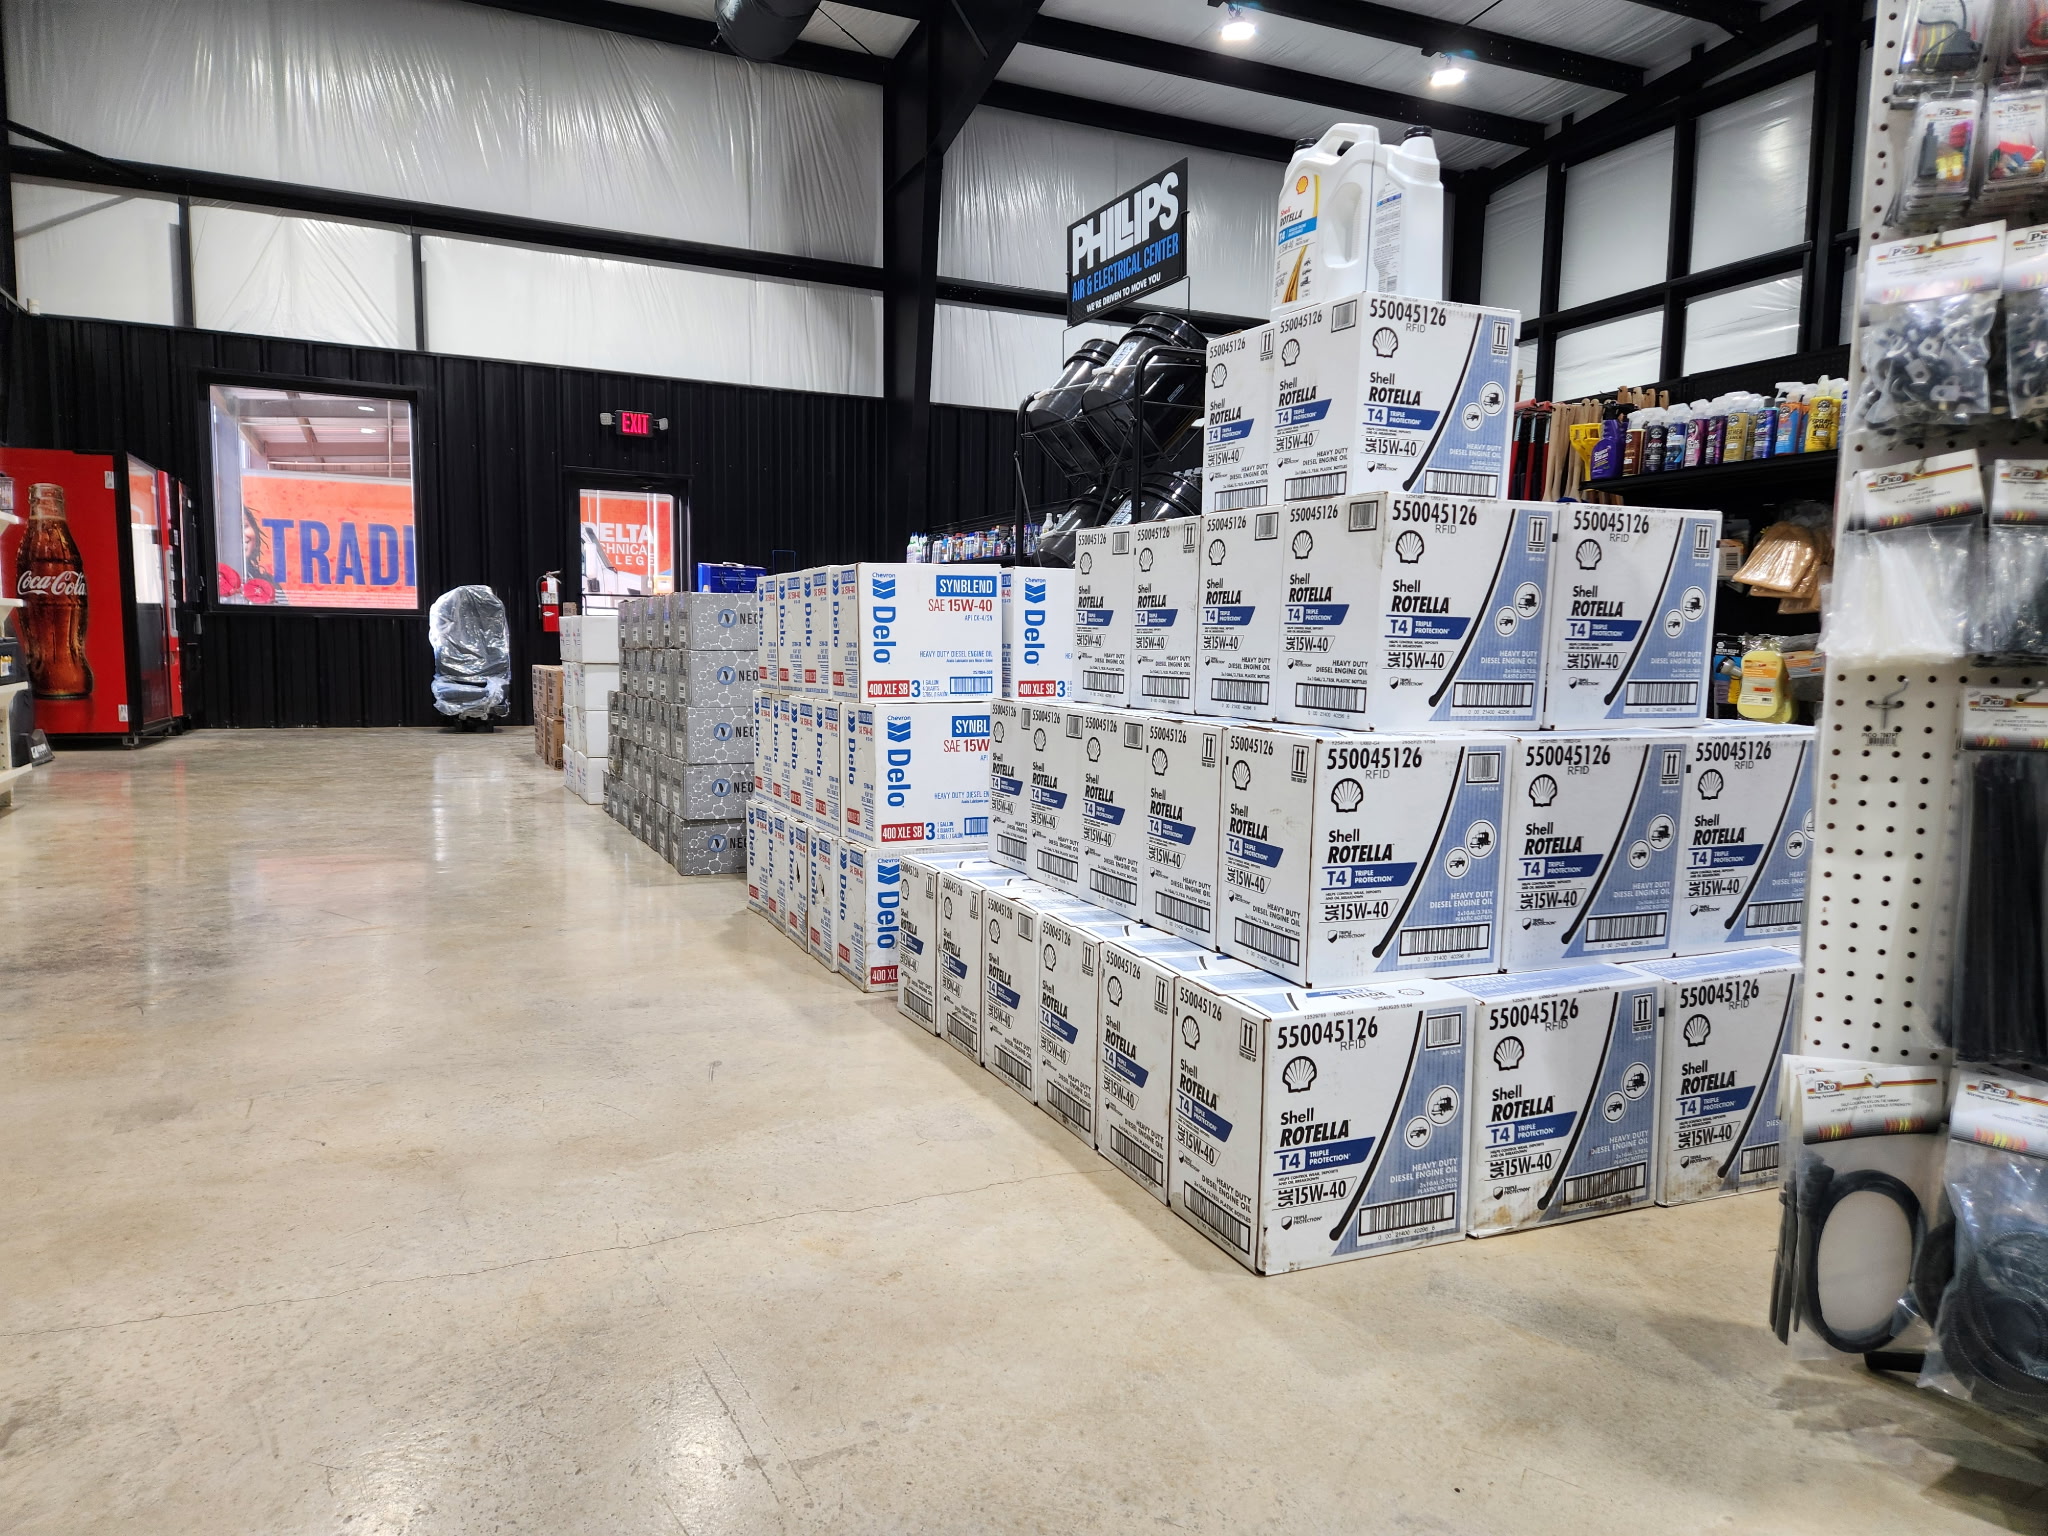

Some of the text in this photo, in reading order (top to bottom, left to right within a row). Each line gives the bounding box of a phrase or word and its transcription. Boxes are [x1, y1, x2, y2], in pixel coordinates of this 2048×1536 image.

[1072, 172, 1179, 277] PHILLIPS
[1072, 232, 1179, 302] AIR & ELECTRICAL CENTER
[1102, 290, 1122, 307] DRIVEN
[1122, 287, 1130, 298] TO
[1131, 279, 1147, 294] MOVE
[1148, 272, 1161, 286] YOU
[1370, 300, 1446, 326] 550045126
[1280, 312, 1322, 333] 550045126
[1406, 323, 1426, 333] RFID
[1210, 338, 1246, 359] 550045126
[1370, 372, 1395, 386] Shell
[1279, 386, 1317, 407] ROTELLA
[1369, 389, 1421, 406] ROTELLA
[622, 412, 649, 435] EXIT
[1368, 408, 1383, 422] T4
[1378, 438, 1416, 456] 15W-40
[1290, 505, 1338, 522] 550045126
[1392, 501, 1477, 525] 550045126
[1574, 511, 1649, 533] 550045126
[1207, 518, 1246, 532] 550045126
[1435, 524, 1456, 534] RFID
[616, 555, 654, 565] LEGE
[18, 570, 87, 596] Coca-Cola
[940, 579, 992, 593] SYNBLEND
[1207, 578, 1223, 588] Shell
[1393, 580, 1420, 592] Shell
[1573, 586, 1598, 598] Shell
[928, 599, 992, 611] SAE 15W-40
[1206, 590, 1241, 605] ROTELLA
[1391, 596, 1449, 614] ROTELLA
[1571, 601, 1623, 617] ROTELLA
[873, 606, 896, 664] Delo
[1391, 620, 1407, 634] T4
[1571, 623, 1585, 636] T4
[1025, 610, 1045, 664] Delo
[1388, 651, 1444, 668] SAE 15W-40
[1580, 653, 1618, 669] 15W-40
[739, 670, 758, 681] NEO
[869, 680, 921, 697] 400 XLE SB 3
[1019, 680, 1065, 697] 400 XLE SB 3
[956, 719, 989, 733] SYNBL
[1150, 727, 1186, 743] 550045126
[944, 739, 989, 752] SAE 15W
[1230, 735, 1273, 755] 550045126
[1696, 741, 1771, 762] 550045126
[848, 738, 856, 785] Delo
[1327, 747, 1422, 770] 550045126
[1526, 744, 1610, 767] 550045126
[887, 749, 911, 808] Delo
[1365, 770, 1390, 779] RFID
[1230, 804, 1248, 817] Shell
[1230, 817, 1268, 841] ROTELLA
[1526, 822, 1553, 835] Shell
[1694, 814, 1720, 826] Shell
[882, 822, 935, 840] 400 XLE SB 3
[1328, 829, 1360, 843] Shell
[1693, 827, 1745, 845] ROTELLA
[1328, 844, 1392, 863] ROTELLA
[1524, 836, 1582, 855] ROTELLA
[1692, 852, 1707, 865] T4
[1524, 862, 1540, 876] T4
[1327, 871, 1346, 886] T4
[1689, 878, 1739, 896] SAE 15W-40
[1520, 891, 1577, 909] SAE 15W-40
[877, 891, 899, 949] Delo
[1325, 901, 1388, 921] SAE 15W-40
[1043, 920, 1071, 946] 550045126
[1106, 949, 1141, 980] 550045126
[872, 968, 898, 981] 400 XL
[1680, 979, 1759, 1008] 550045126
[1180, 987, 1222, 1022] 550045126
[1729, 998, 1750, 1011] RFID
[1489, 998, 1579, 1030] 550045126
[1278, 1016, 1378, 1049] 550045126
[1545, 1019, 1568, 1032] RFID
[1340, 1038, 1366, 1051] RFID
[1181, 1059, 1198, 1079] Shell
[1682, 1060, 1708, 1076] Shell
[1180, 1073, 1218, 1111] ROTELLA
[1681, 1071, 1736, 1096] ROTELLA
[1492, 1085, 1522, 1101] Shell
[1179, 1097, 1190, 1115] T4
[1492, 1095, 1554, 1122] ROTELLA
[1680, 1100, 1696, 1115] T4
[1280, 1107, 1314, 1125] Shell
[1280, 1119, 1350, 1148] ROTELLA
[1491, 1127, 1509, 1143] T4
[1692, 1124, 1732, 1146] 15W-40
[1186, 1130, 1214, 1165] 15W-40
[1309, 1149, 1330, 1158] TRIPLE
[1280, 1153, 1300, 1170] T4
[1309, 1153, 1351, 1165] PROTECTION
[1412, 1158, 1458, 1172] HEAVY DUTY
[1490, 1153, 1552, 1178] SAE 15W-40
[1390, 1166, 1458, 1183] DIESEL ENGINE OIL
[1278, 1180, 1347, 1207] SAE 15W-40
